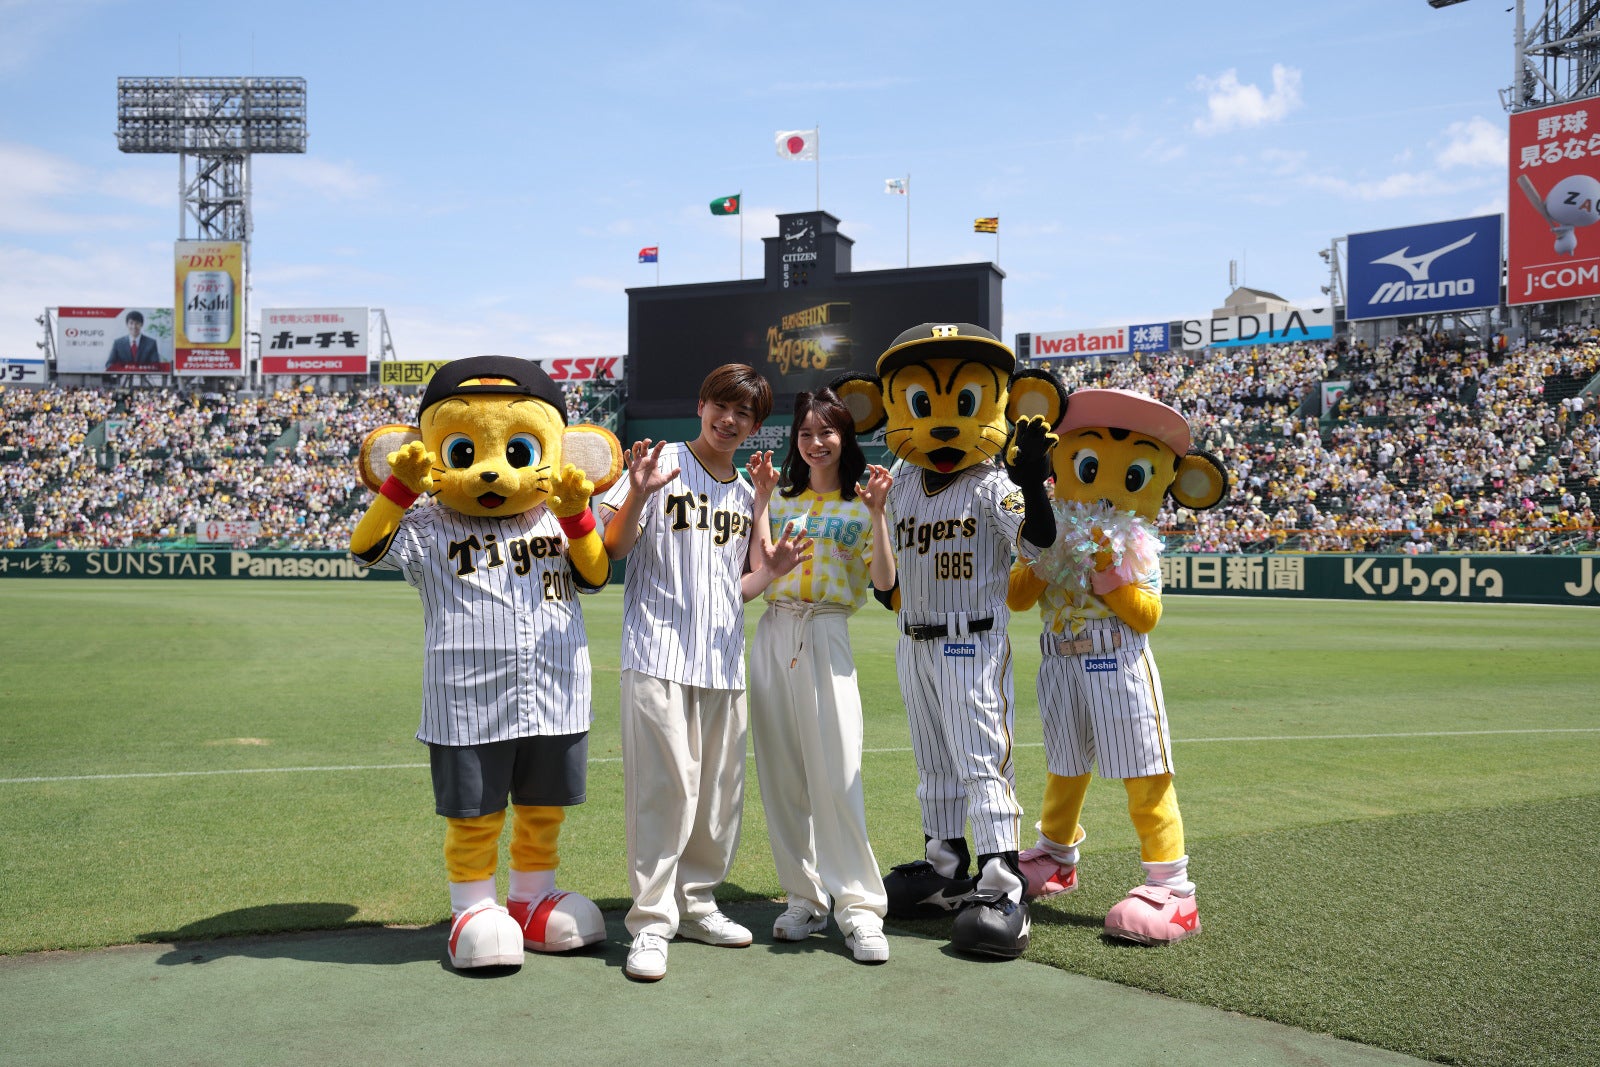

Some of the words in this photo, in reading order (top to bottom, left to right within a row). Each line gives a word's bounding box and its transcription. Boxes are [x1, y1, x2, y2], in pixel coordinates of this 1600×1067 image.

[1538, 110, 1588, 140] 野球
[1519, 133, 1600, 169] 見るなら
[783, 252, 817, 262] CITIZEN
[1524, 266, 1598, 296] J:COM
[188, 294, 229, 311] Asahi
[781, 304, 828, 329] HANSHIN
[80, 329, 105, 337] MUFG
[270, 330, 360, 349] ホーチキ
[1035, 328, 1124, 354] Iwatani
[1133, 326, 1165, 343] 水素
[766, 327, 831, 375] Tigers
[549, 358, 619, 380] SSK
[896, 516, 977, 555] Tigers
[86, 552, 217, 575] SUNSTAR
[231, 552, 370, 578] Panasonic
[934, 552, 974, 580] 1985
[1160, 556, 1304, 590] 朝日新聞
[1344, 557, 1503, 597] Kubota
[1564, 558, 1600, 597] J
[944, 645, 975, 656] Joshin
[1086, 660, 1117, 670] Joshin
